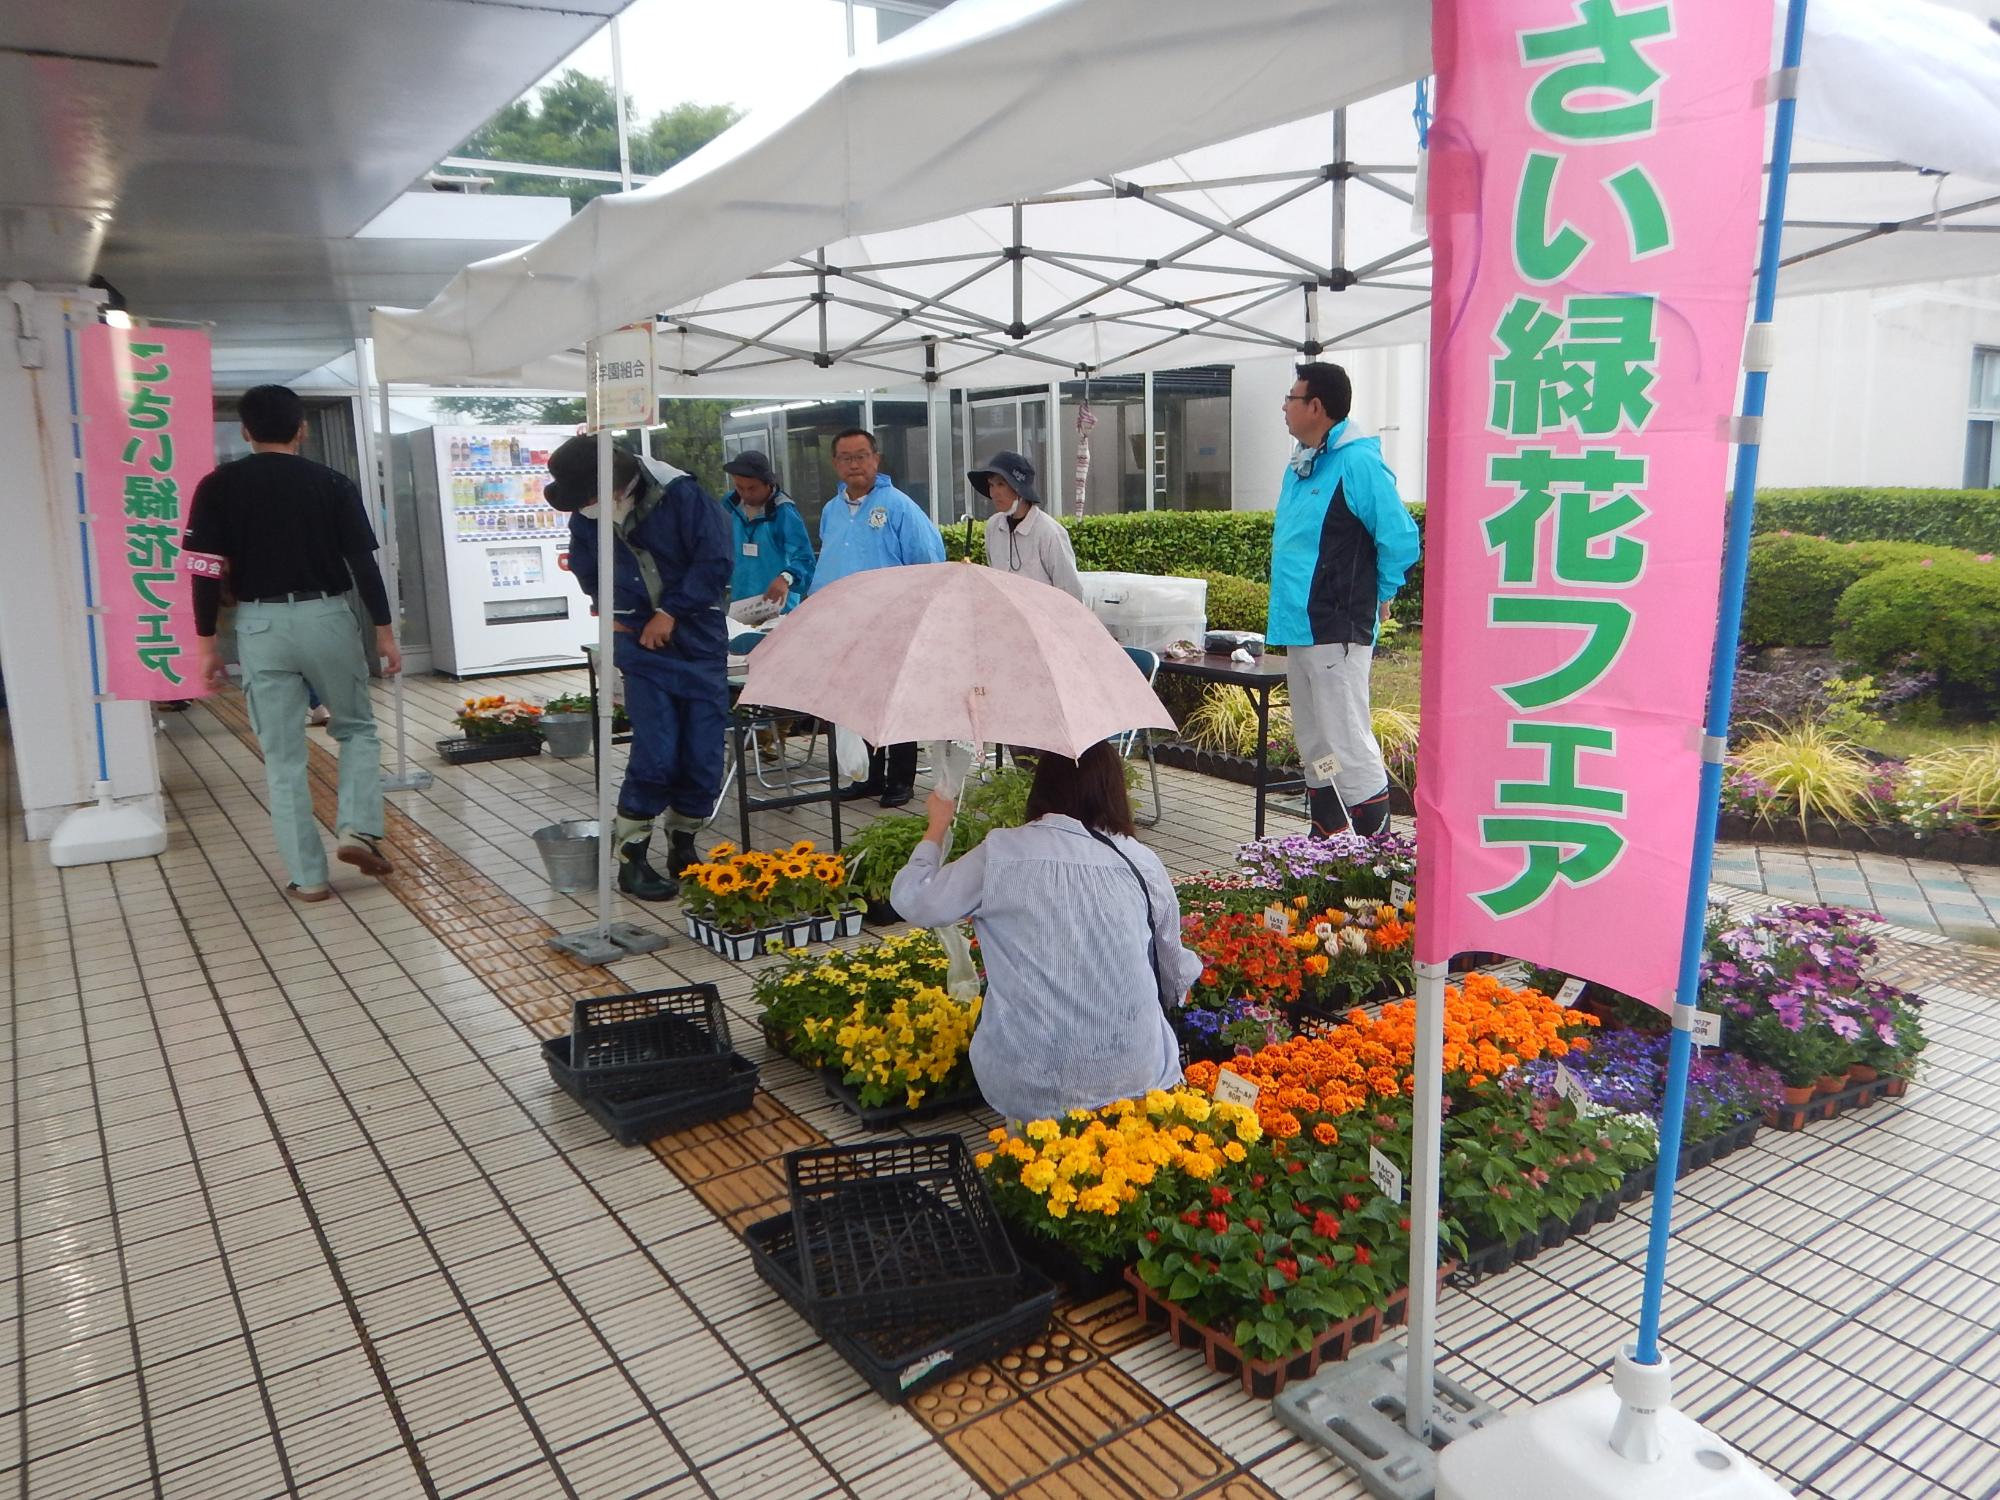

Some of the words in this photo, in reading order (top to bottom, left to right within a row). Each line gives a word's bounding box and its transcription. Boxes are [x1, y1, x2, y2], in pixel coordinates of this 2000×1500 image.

[1468, 0, 1678, 920] さい緑花フェア
